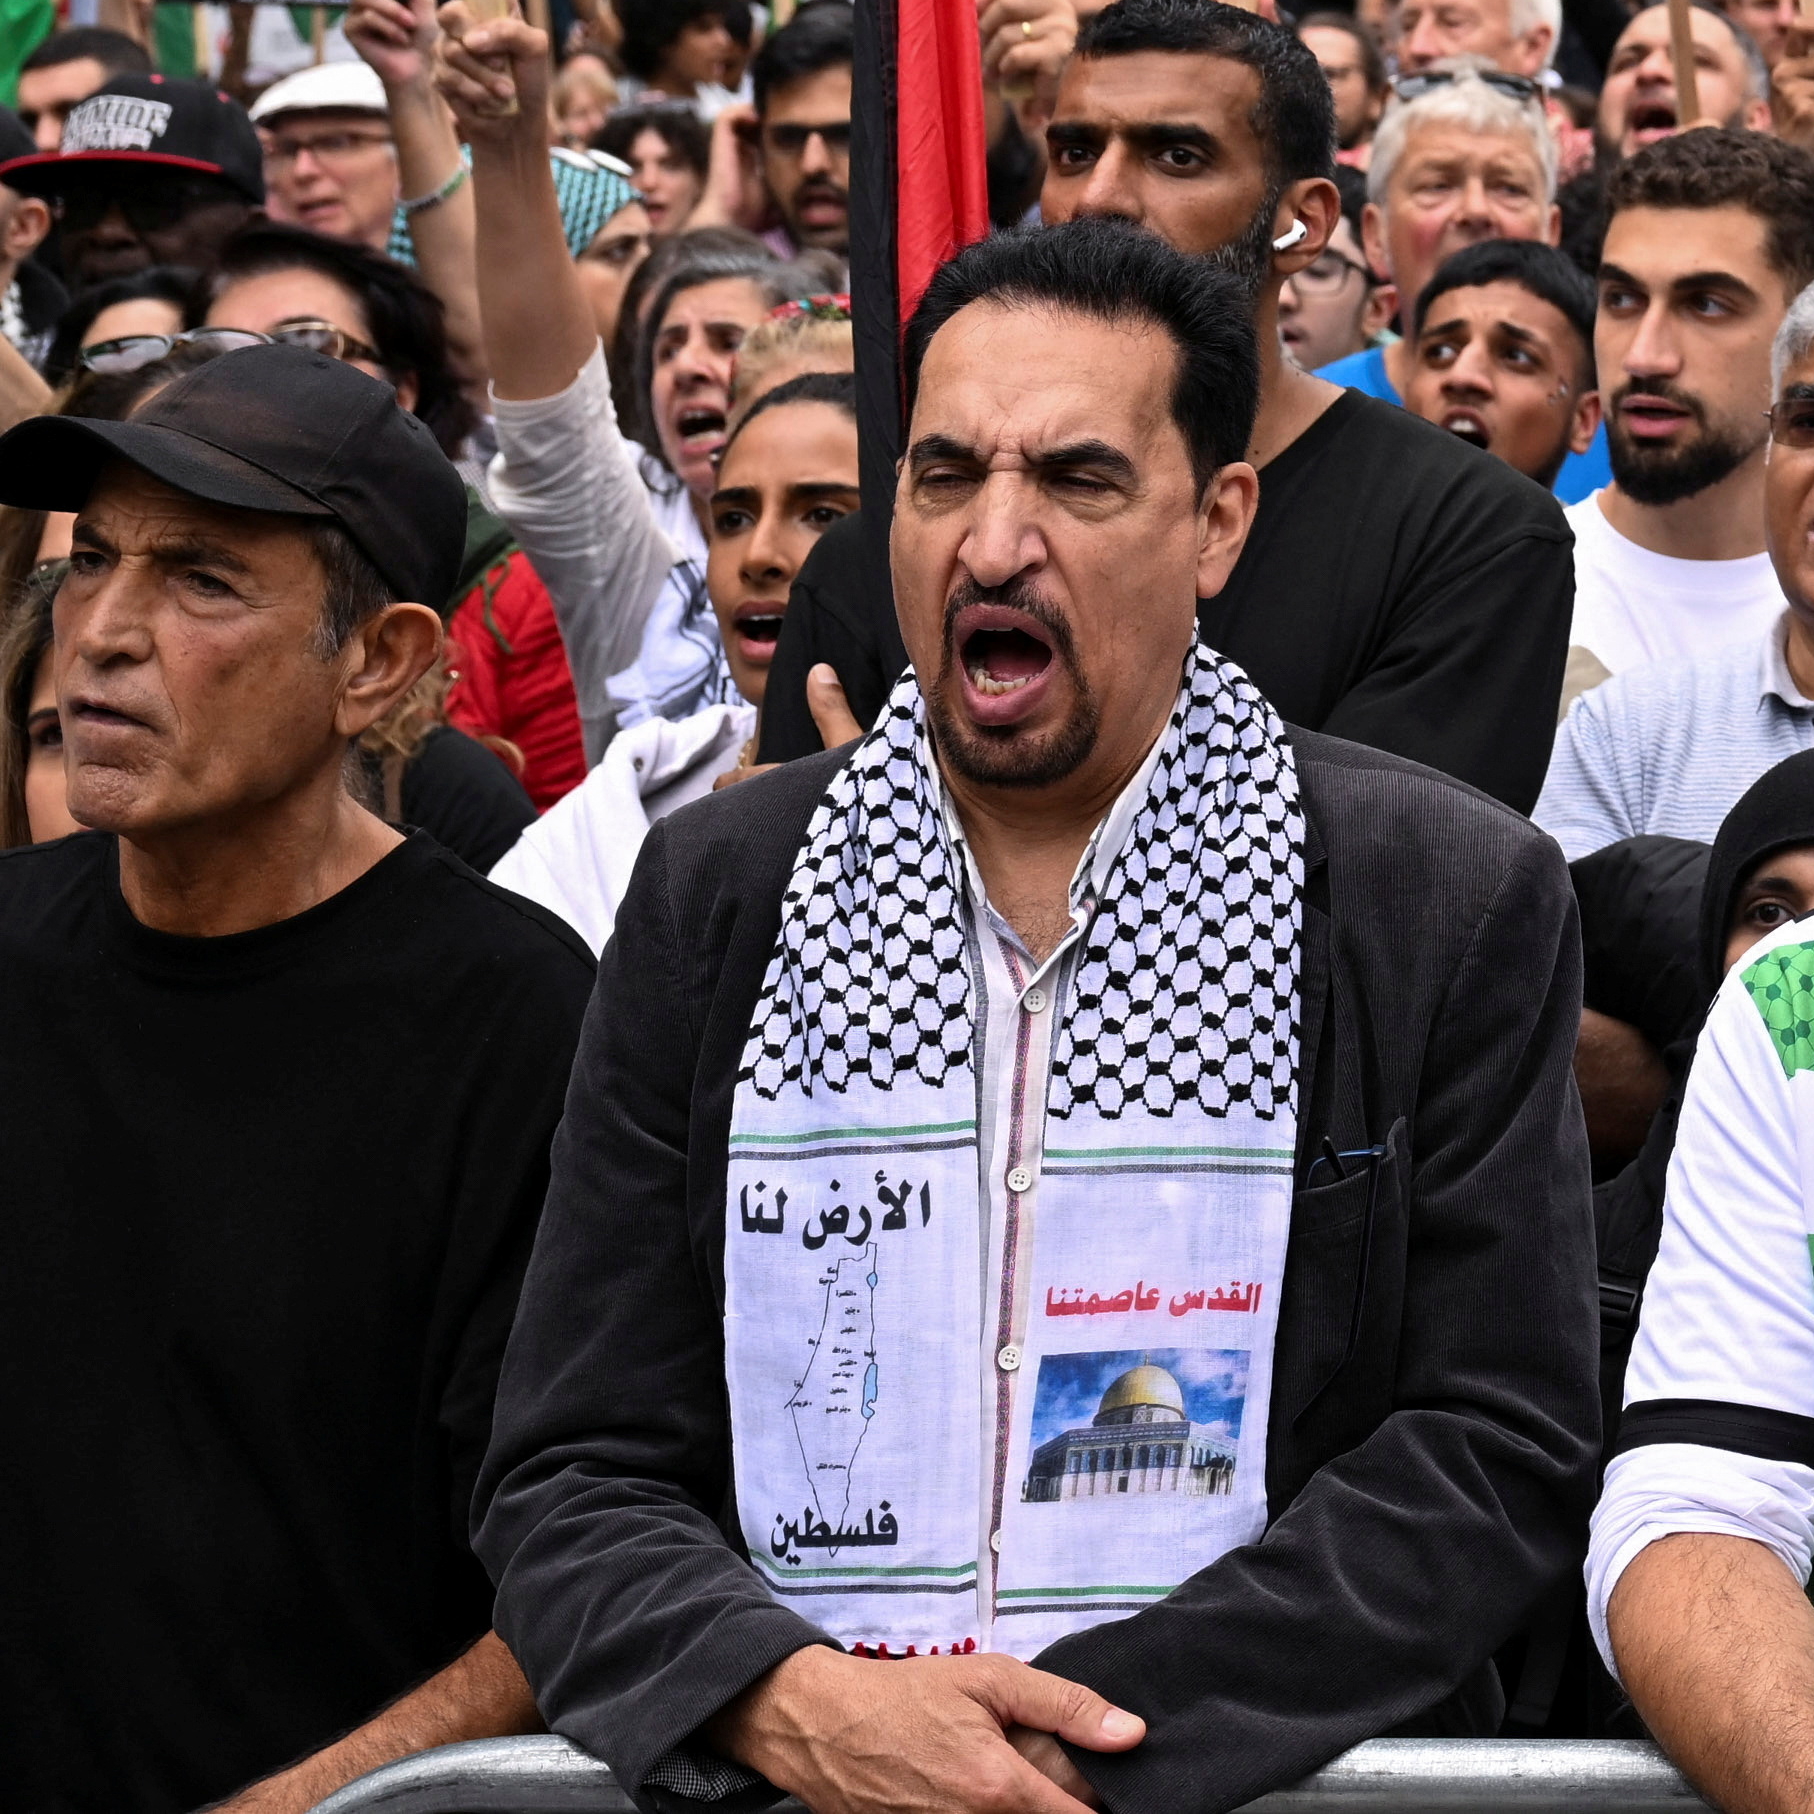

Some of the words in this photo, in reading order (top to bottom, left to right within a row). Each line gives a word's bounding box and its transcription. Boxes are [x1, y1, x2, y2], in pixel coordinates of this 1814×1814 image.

[738, 1178, 788, 1236] لنا
[801, 1170, 932, 1251] الأرض
[1044, 1282, 1161, 1318] عاصمتنا
[1167, 1281, 1262, 1318] القدس
[769, 1499, 900, 1567] فلسطين
